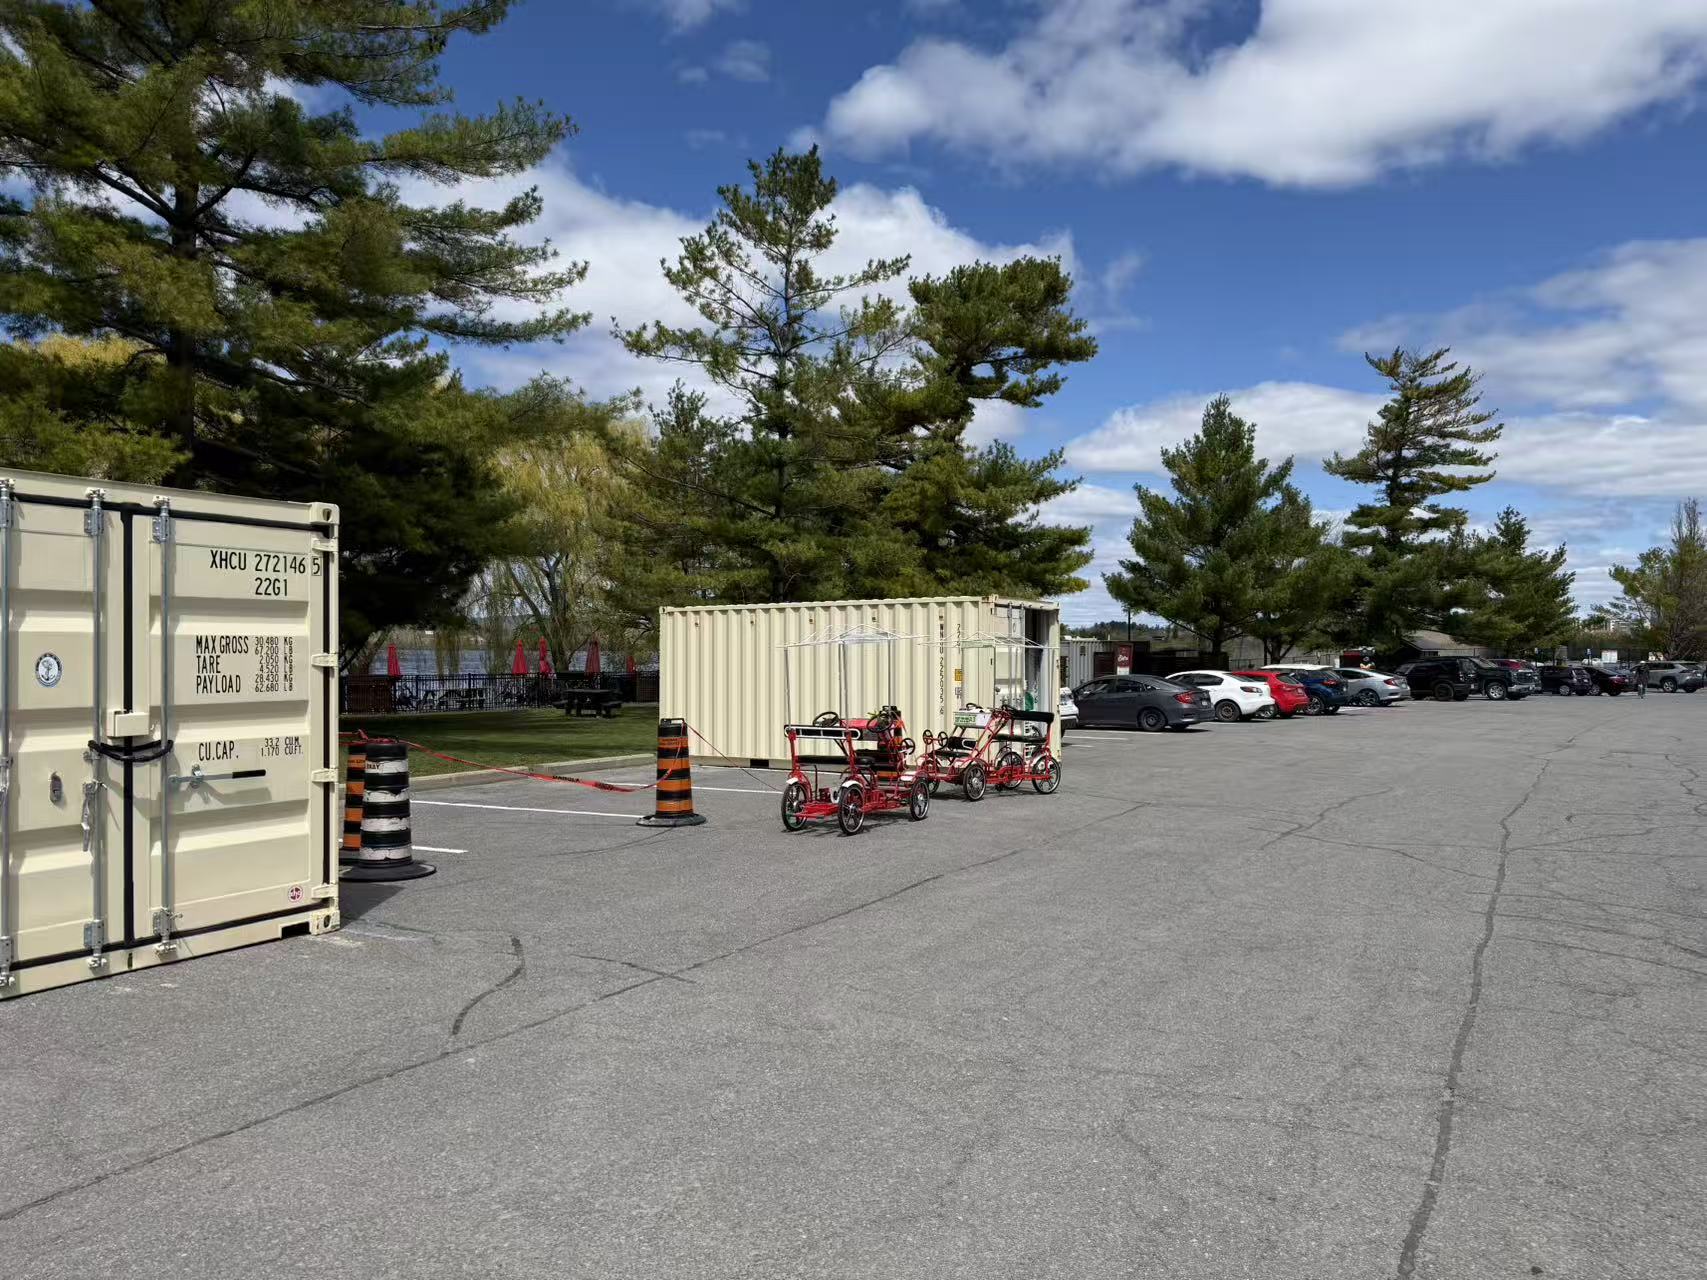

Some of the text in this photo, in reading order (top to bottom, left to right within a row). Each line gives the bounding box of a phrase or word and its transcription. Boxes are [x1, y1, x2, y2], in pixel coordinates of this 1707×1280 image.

[210, 549, 321, 574] XHCU 272146 5
[254, 577, 288, 597] 22G1
[195, 635, 249, 654] MAX GROSS
[196, 655, 221, 674] TARE
[196, 674, 241, 694] PAYLOAD
